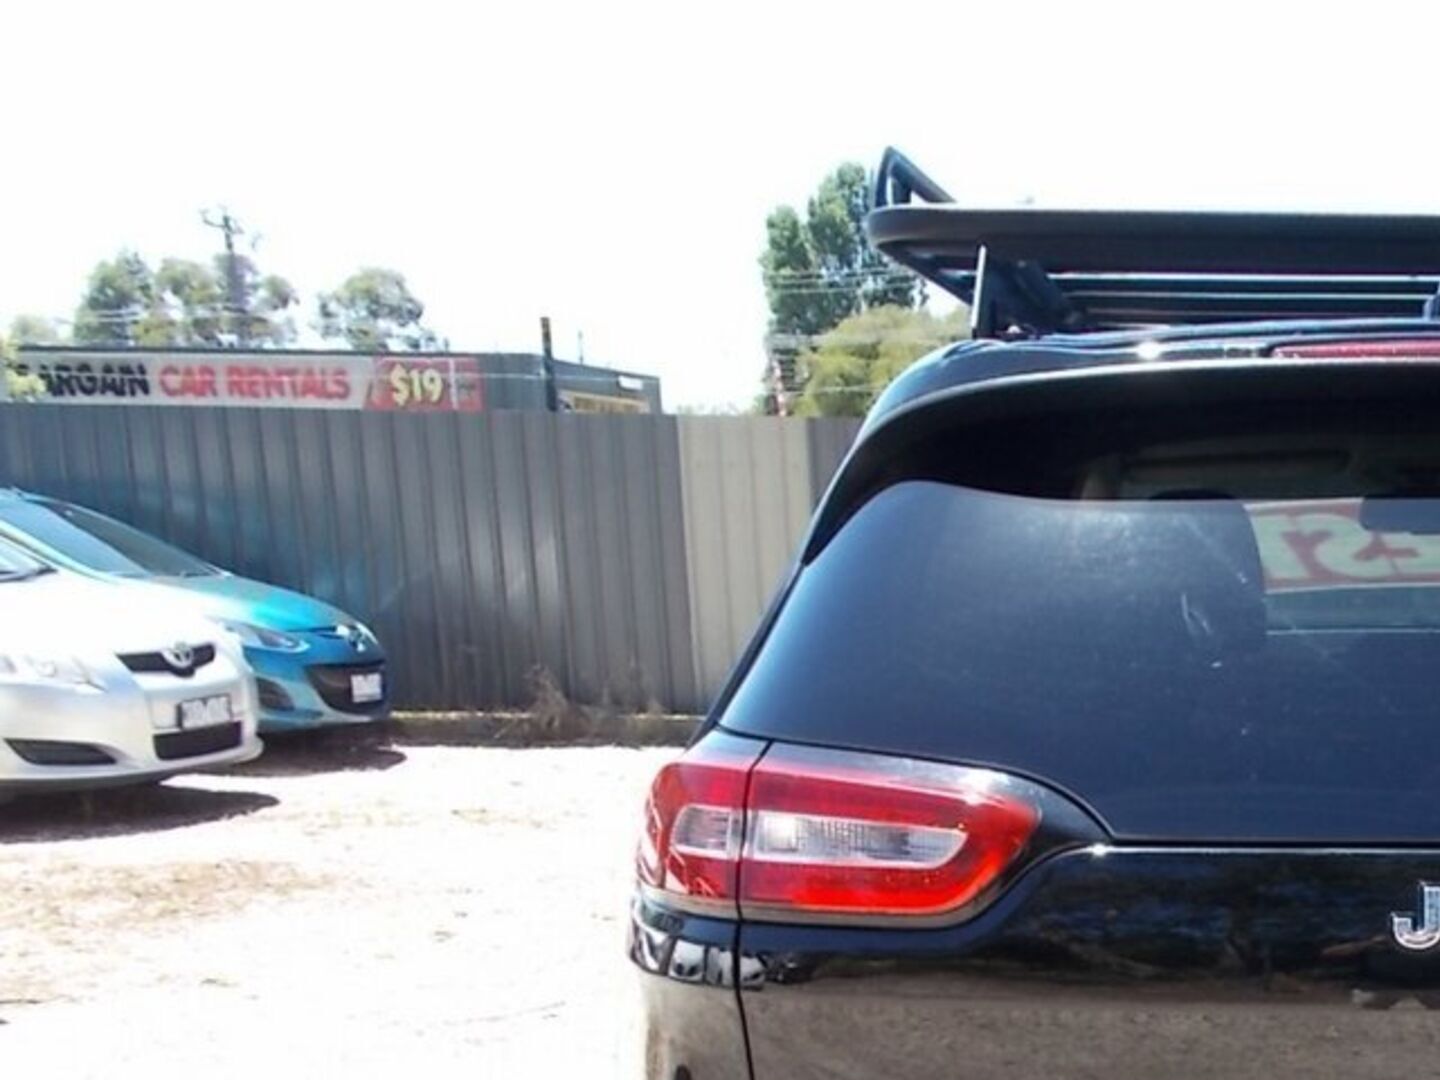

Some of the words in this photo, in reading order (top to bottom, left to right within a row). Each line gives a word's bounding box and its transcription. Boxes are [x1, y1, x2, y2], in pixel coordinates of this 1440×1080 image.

[8, 362, 150, 397] ARGAIN
[160, 364, 218, 398] CAR
[227, 365, 351, 401] RENTALS
[389, 362, 445, 407] $19
